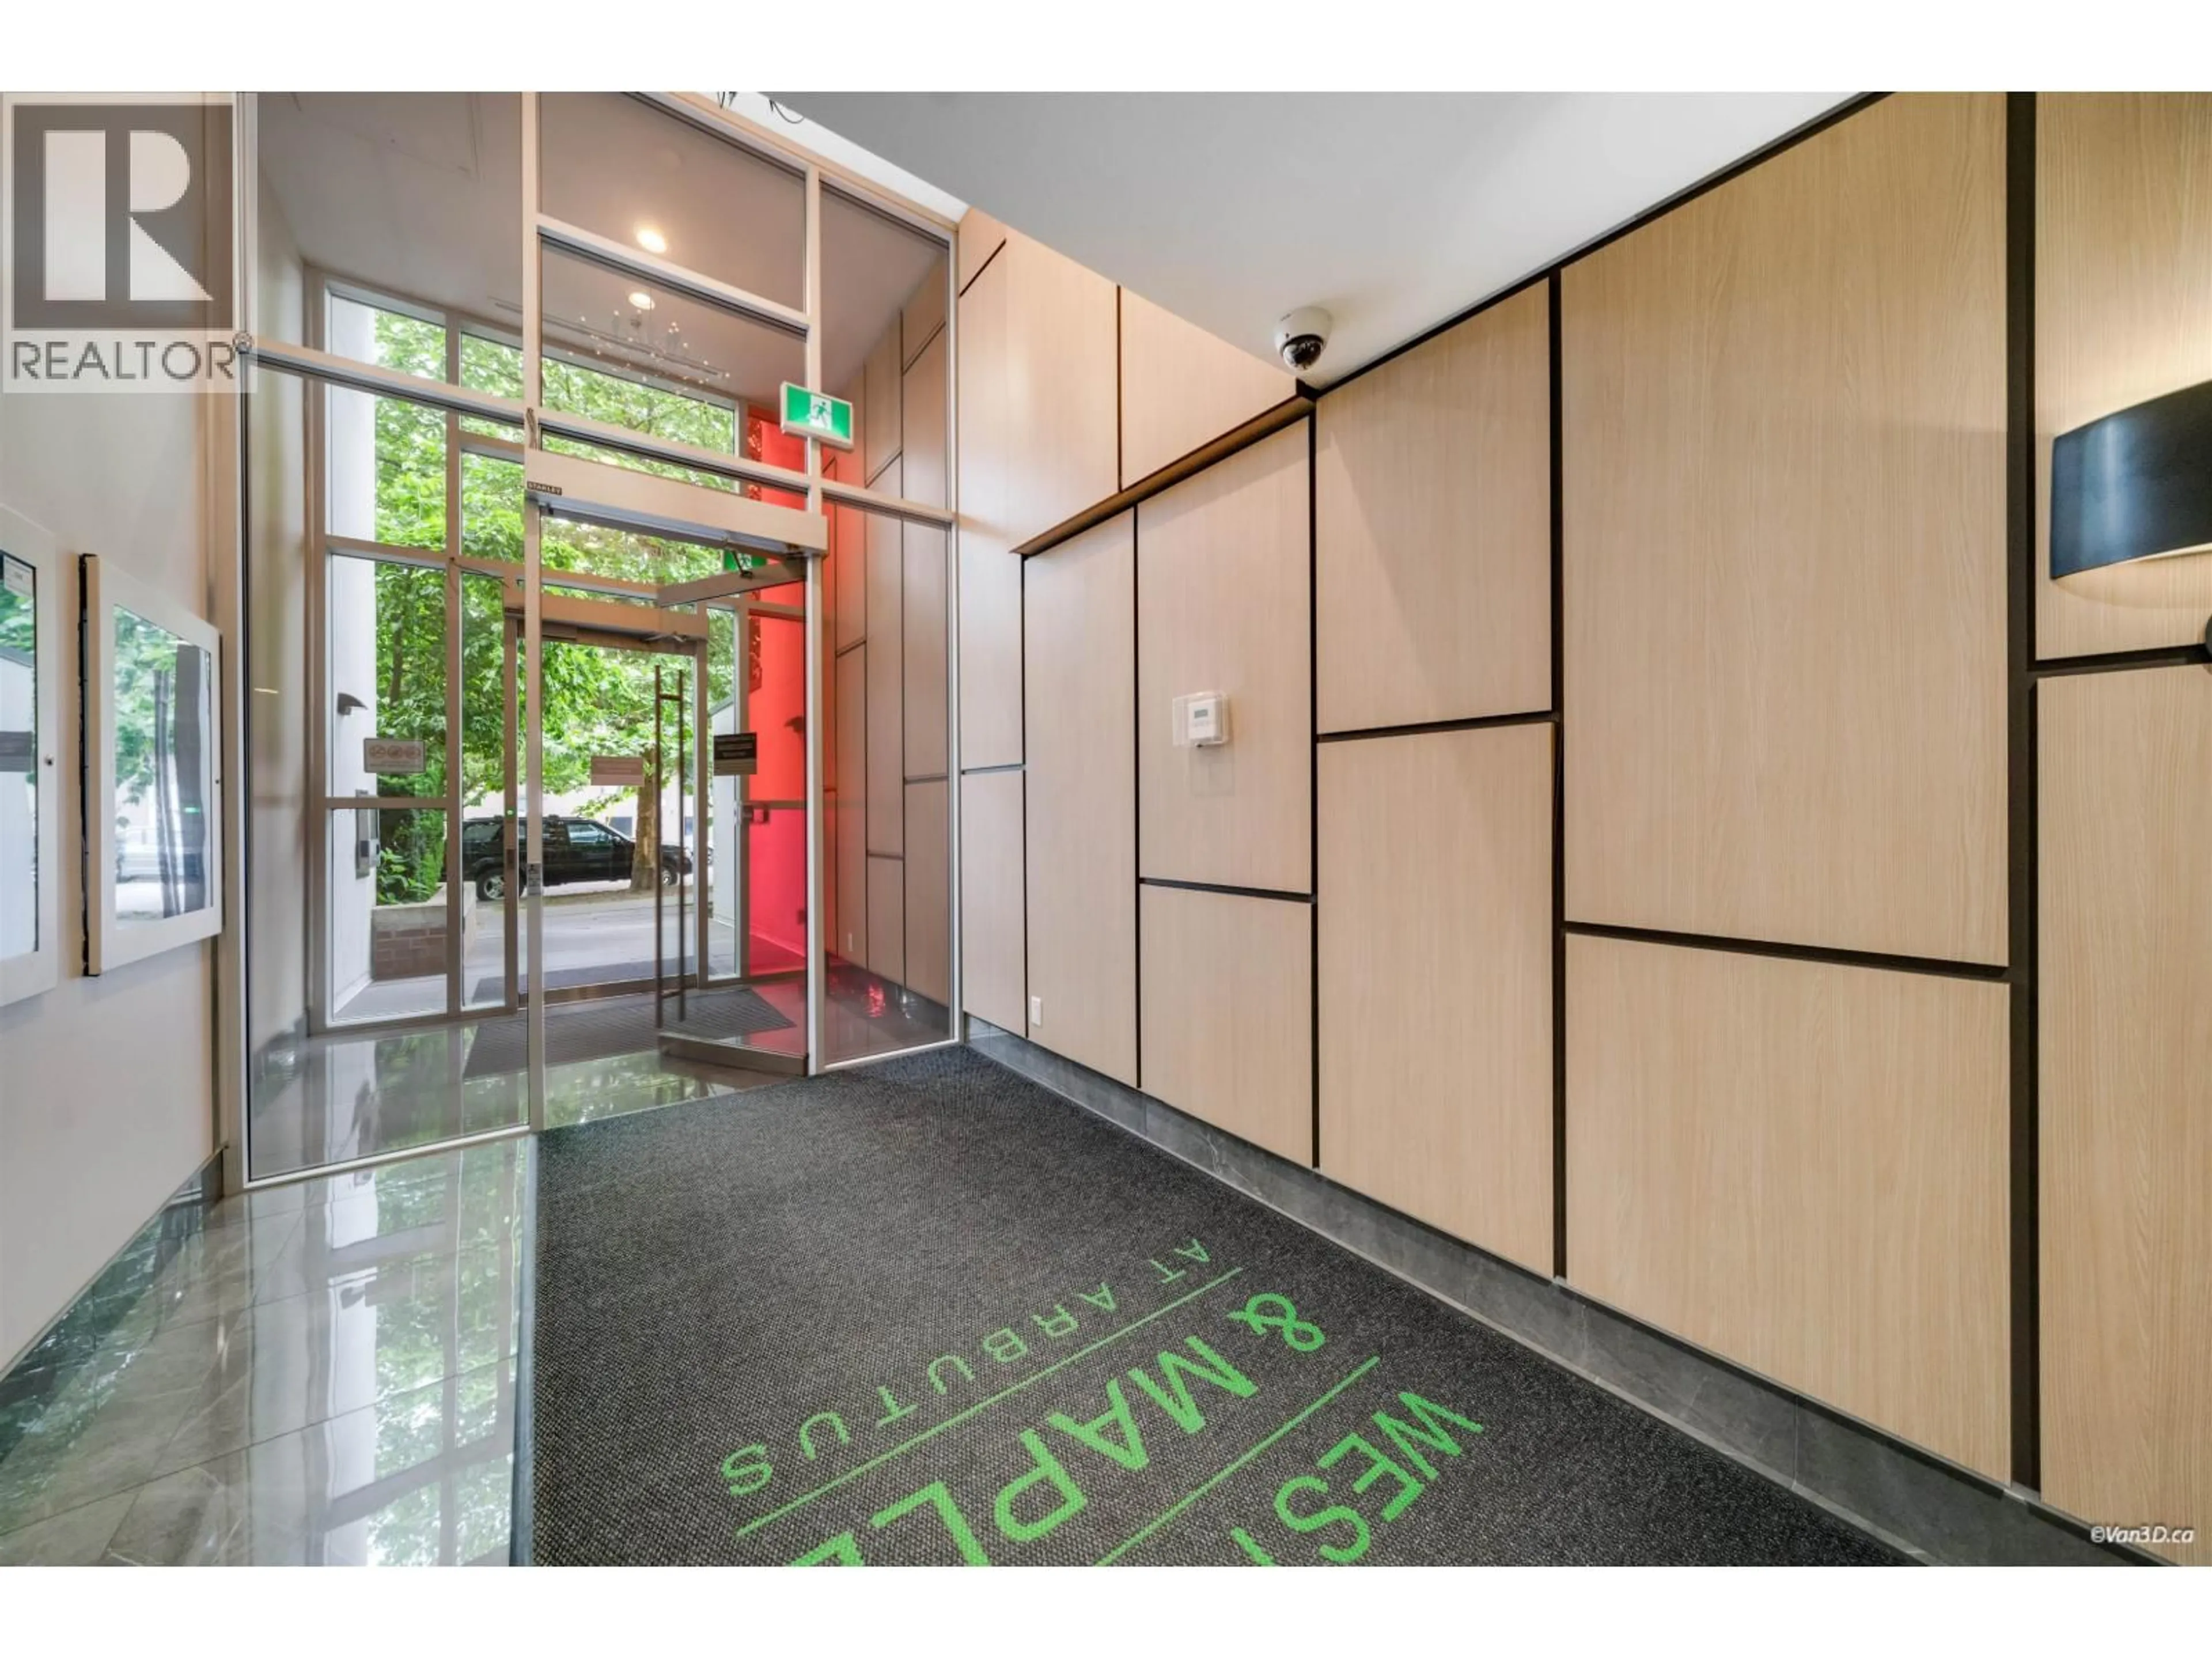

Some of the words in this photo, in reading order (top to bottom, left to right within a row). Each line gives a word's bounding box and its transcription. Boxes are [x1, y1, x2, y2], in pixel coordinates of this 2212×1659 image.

[1148, 1238, 1211, 1284] AT
[1227, 1293, 1325, 1351] &
[721, 1282, 1116, 1496] ARBUTUS
